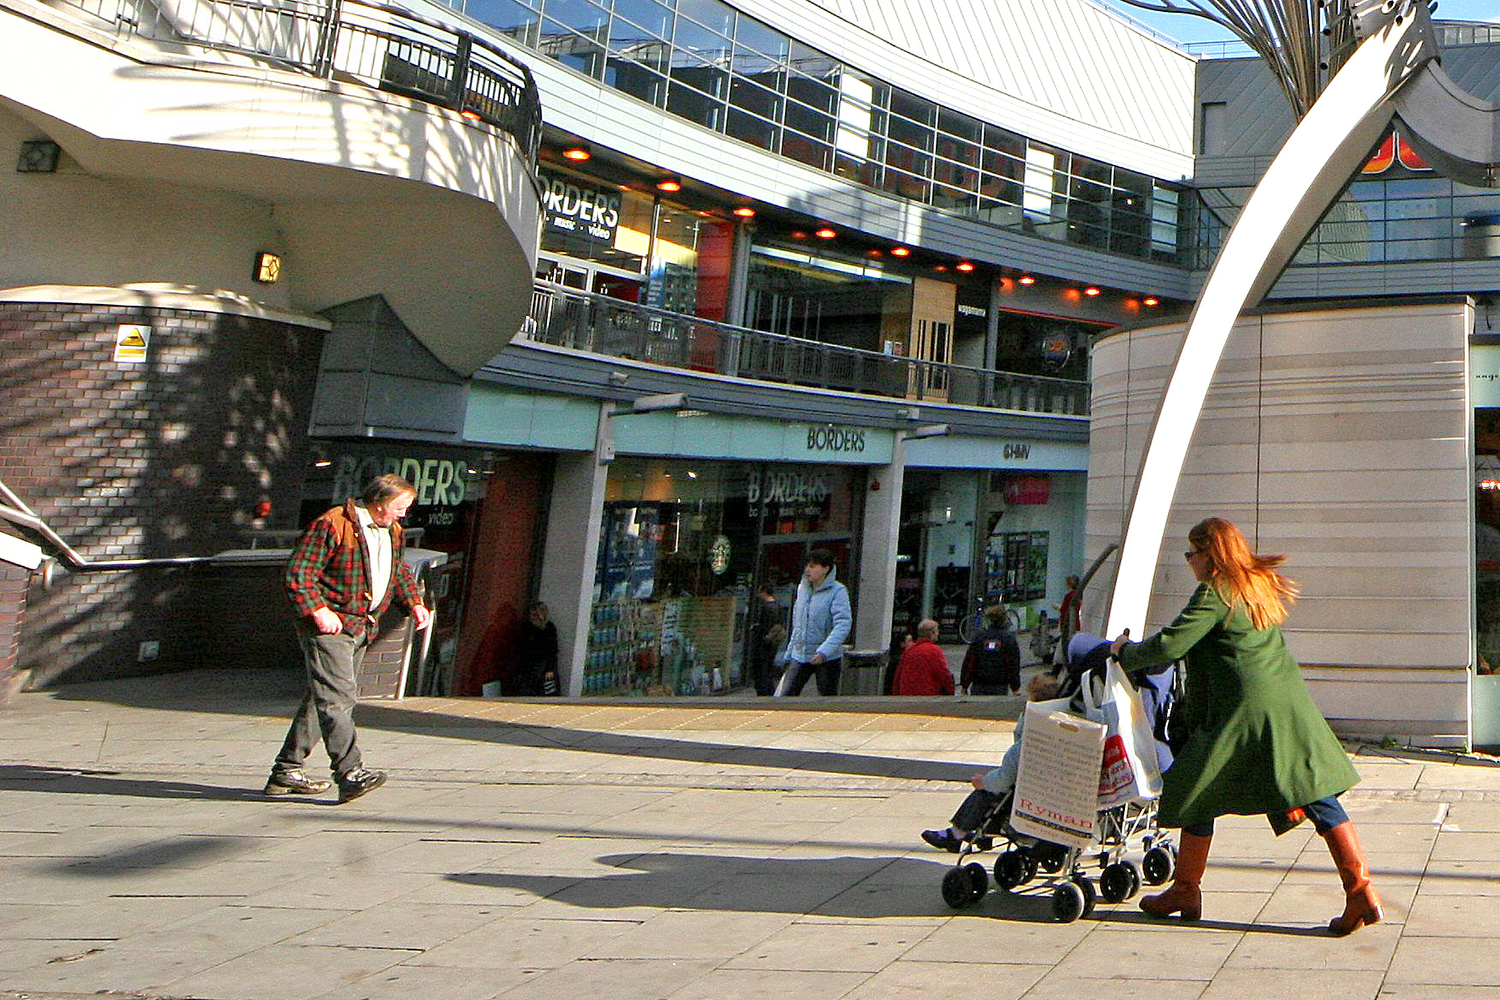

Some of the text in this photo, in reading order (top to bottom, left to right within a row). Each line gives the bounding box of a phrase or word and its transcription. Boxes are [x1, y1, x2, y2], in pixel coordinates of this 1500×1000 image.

[538, 176, 620, 228] ORDERS
[588, 222, 611, 240] video
[807, 426, 866, 453] BORDERS
[1020, 798, 1094, 829] Ryman
